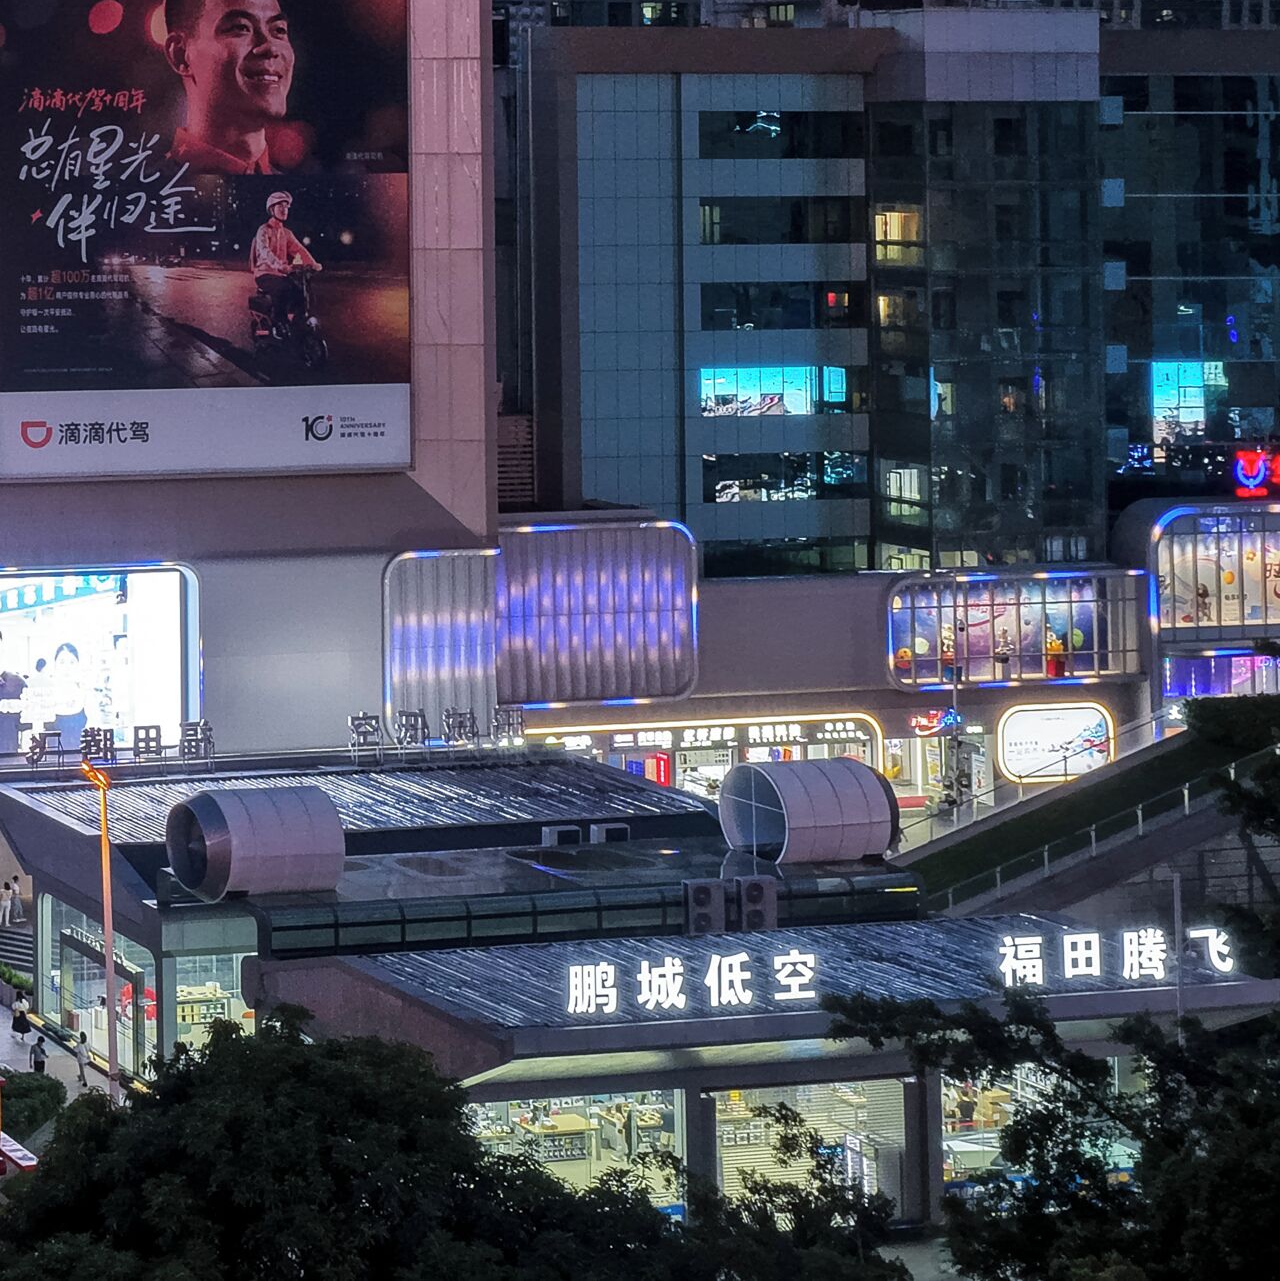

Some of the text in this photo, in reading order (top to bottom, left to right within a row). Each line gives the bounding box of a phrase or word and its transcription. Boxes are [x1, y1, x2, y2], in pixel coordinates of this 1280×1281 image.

[18, 88, 147, 118] 滴滴代驾十周年
[19, 118, 160, 191] 总有星光
[46, 162, 216, 263] 伴归途
[58, 421, 150, 445] 滴滴代驾
[567, 927, 1234, 1014] 鹏城低空 福田腾飞
